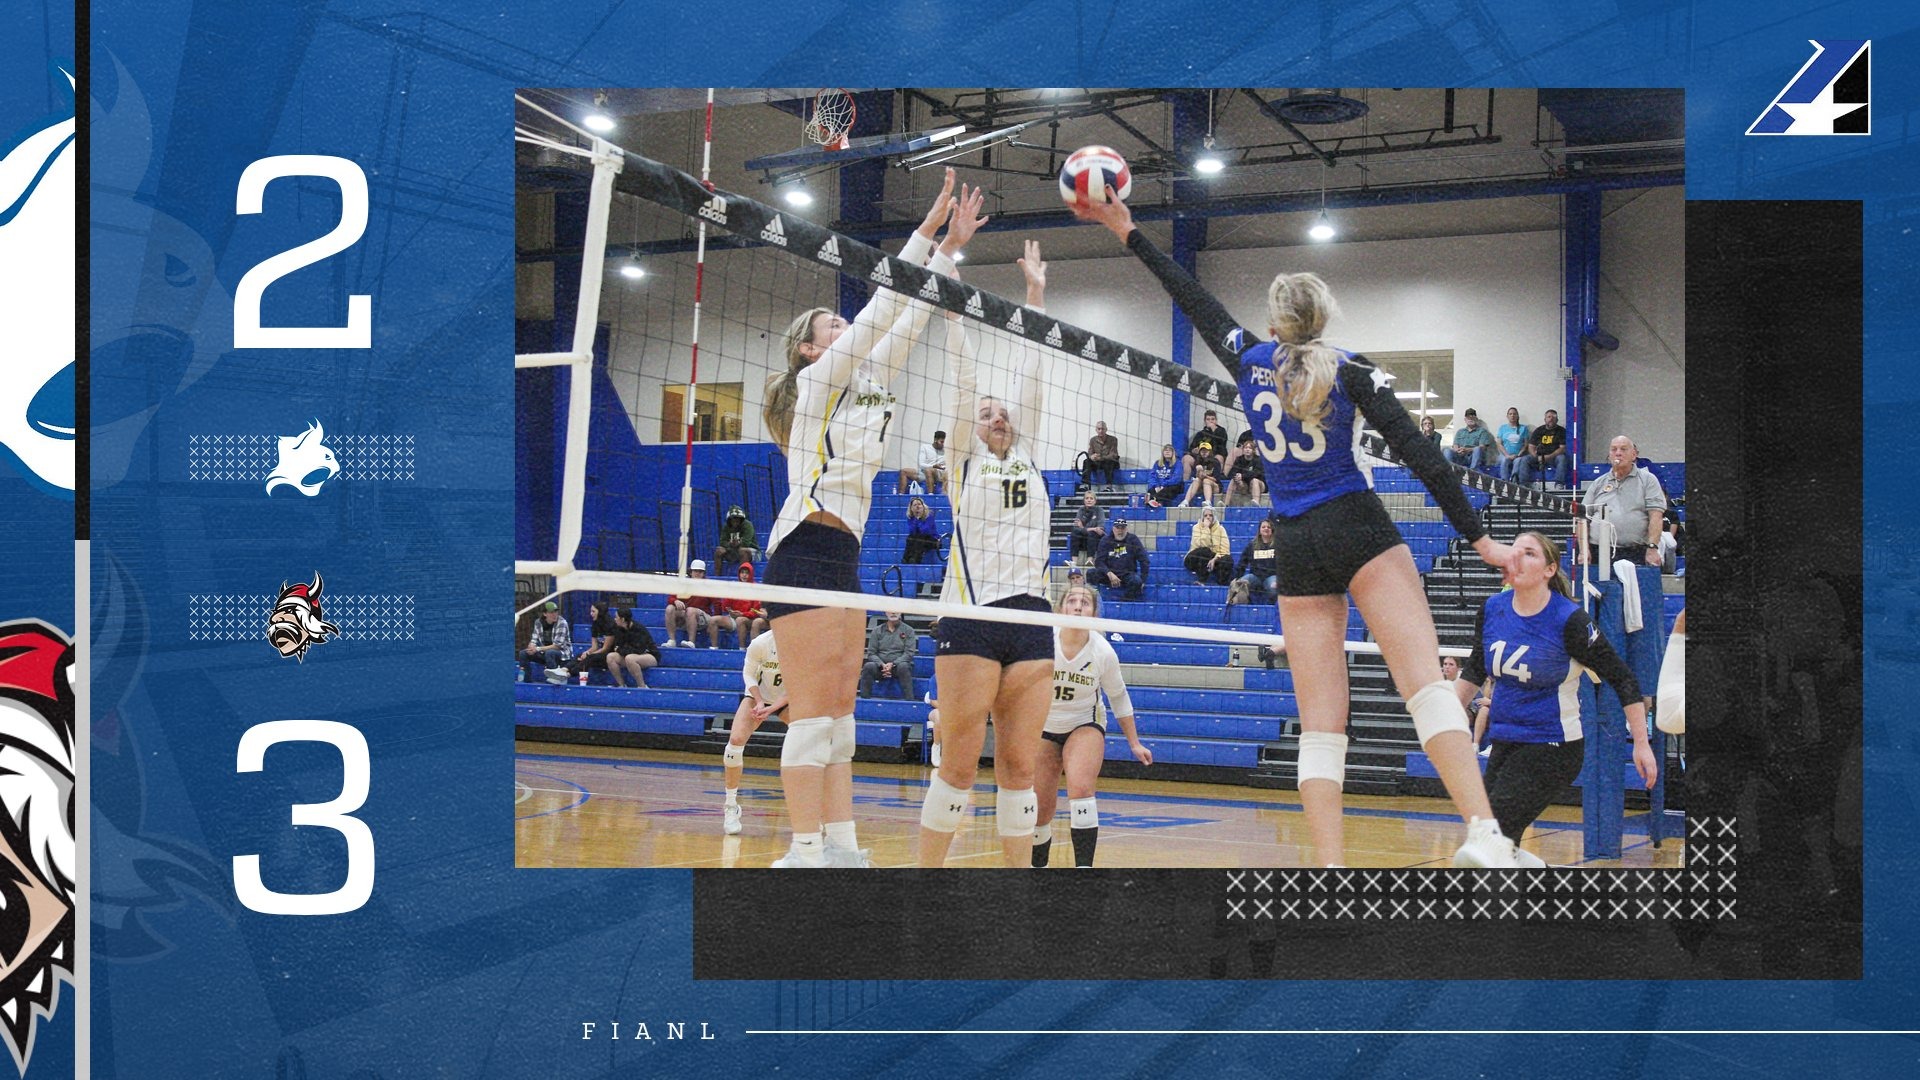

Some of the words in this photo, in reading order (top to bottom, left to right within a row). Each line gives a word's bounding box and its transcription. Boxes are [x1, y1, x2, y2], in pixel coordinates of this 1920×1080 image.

[698, 206, 728, 225] adidas
[760, 230, 788, 247] adidas
[817, 250, 843, 266] adidas
[870, 271, 893, 287] adidas
[919, 289, 940, 303] adidas
[964, 304, 985, 318] adidas
[1005, 321, 1025, 335] adidas
[1045, 335, 1063, 348] adidas
[879, 410, 892, 443] 7
[1252, 390, 1327, 463] 33
[1001, 478, 1028, 509] 16
[1489, 639, 1532, 684] 14
[1068, 671, 1095, 687] MERCY
[1054, 685, 1075, 701] 15
